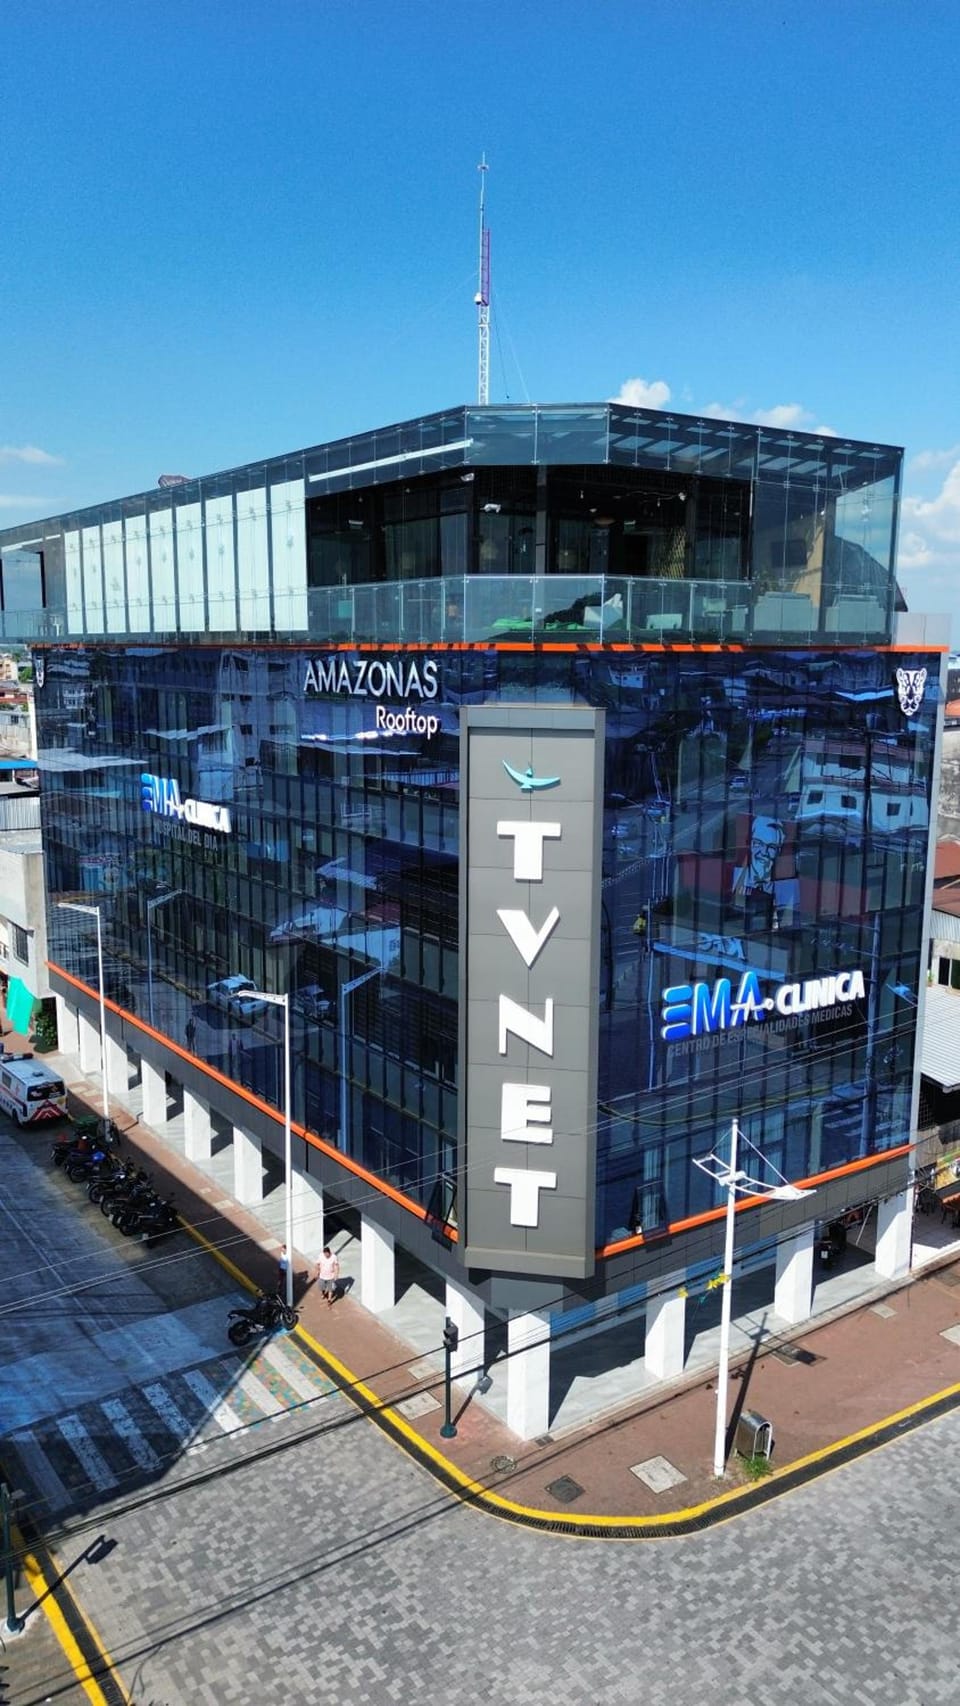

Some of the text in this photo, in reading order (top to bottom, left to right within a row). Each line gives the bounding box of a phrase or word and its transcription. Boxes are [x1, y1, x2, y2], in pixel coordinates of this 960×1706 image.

[303, 660, 438, 698] AMAZONAS
[375, 705, 438, 740] Rooftop
[184, 799, 232, 834] CLCA
[493, 821, 562, 1228] TVNET
[661, 970, 866, 1042] EMA CLINICA
[666, 1004, 853, 1058] CENTRO DE ESEIALIDADES MEDICAS
